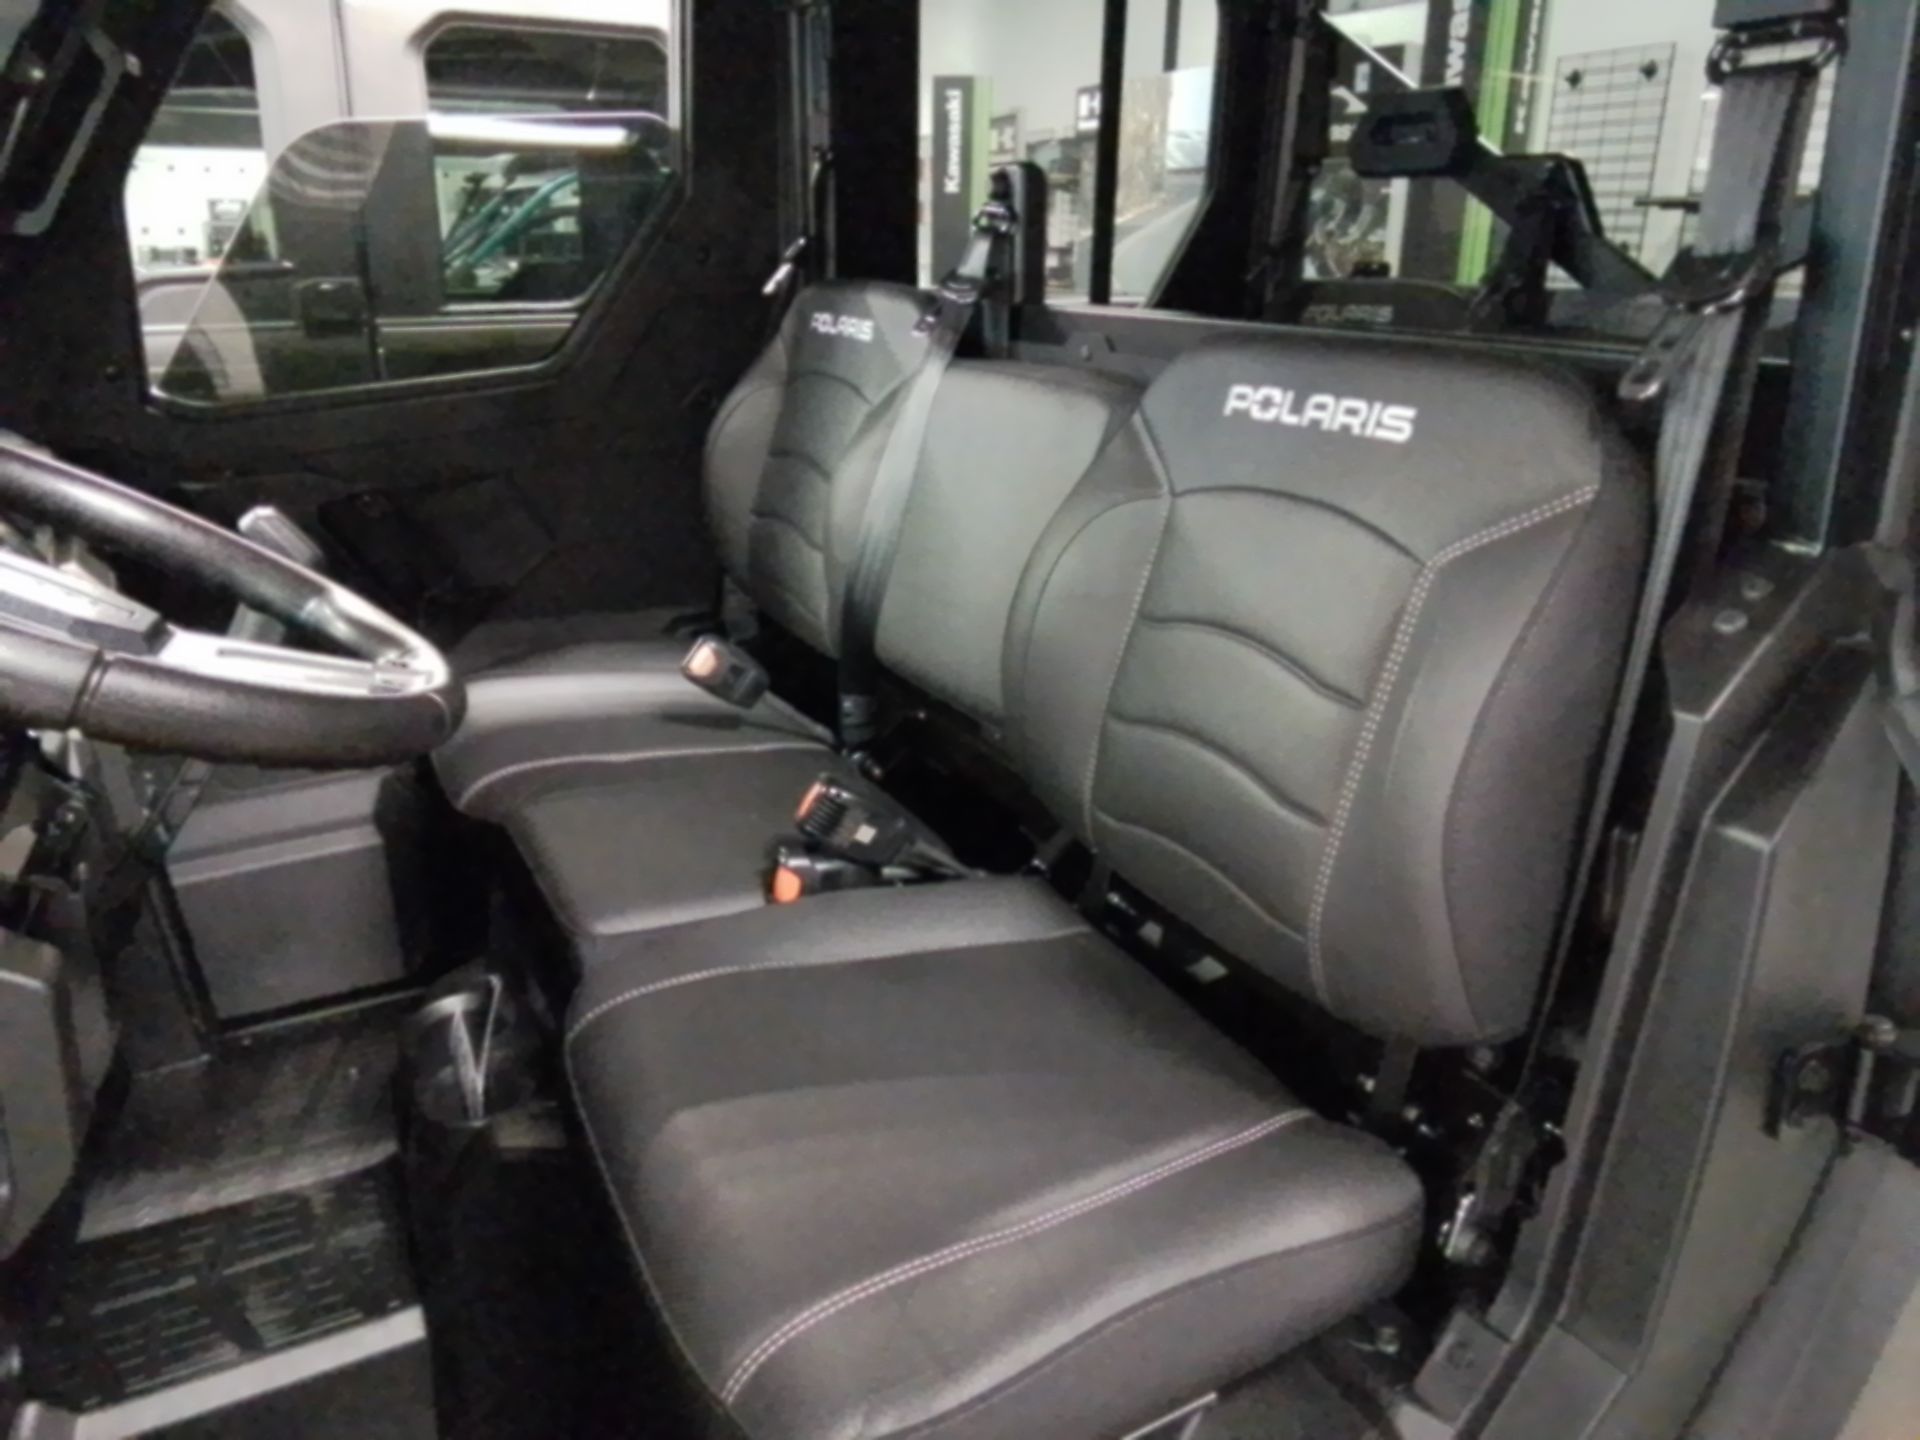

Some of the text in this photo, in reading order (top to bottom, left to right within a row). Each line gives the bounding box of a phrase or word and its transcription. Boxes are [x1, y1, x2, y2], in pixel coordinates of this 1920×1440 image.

[944, 88, 962, 194] Kawasaki
[811, 312, 874, 342] POLARIS
[1224, 384, 1417, 443] POLARIS
